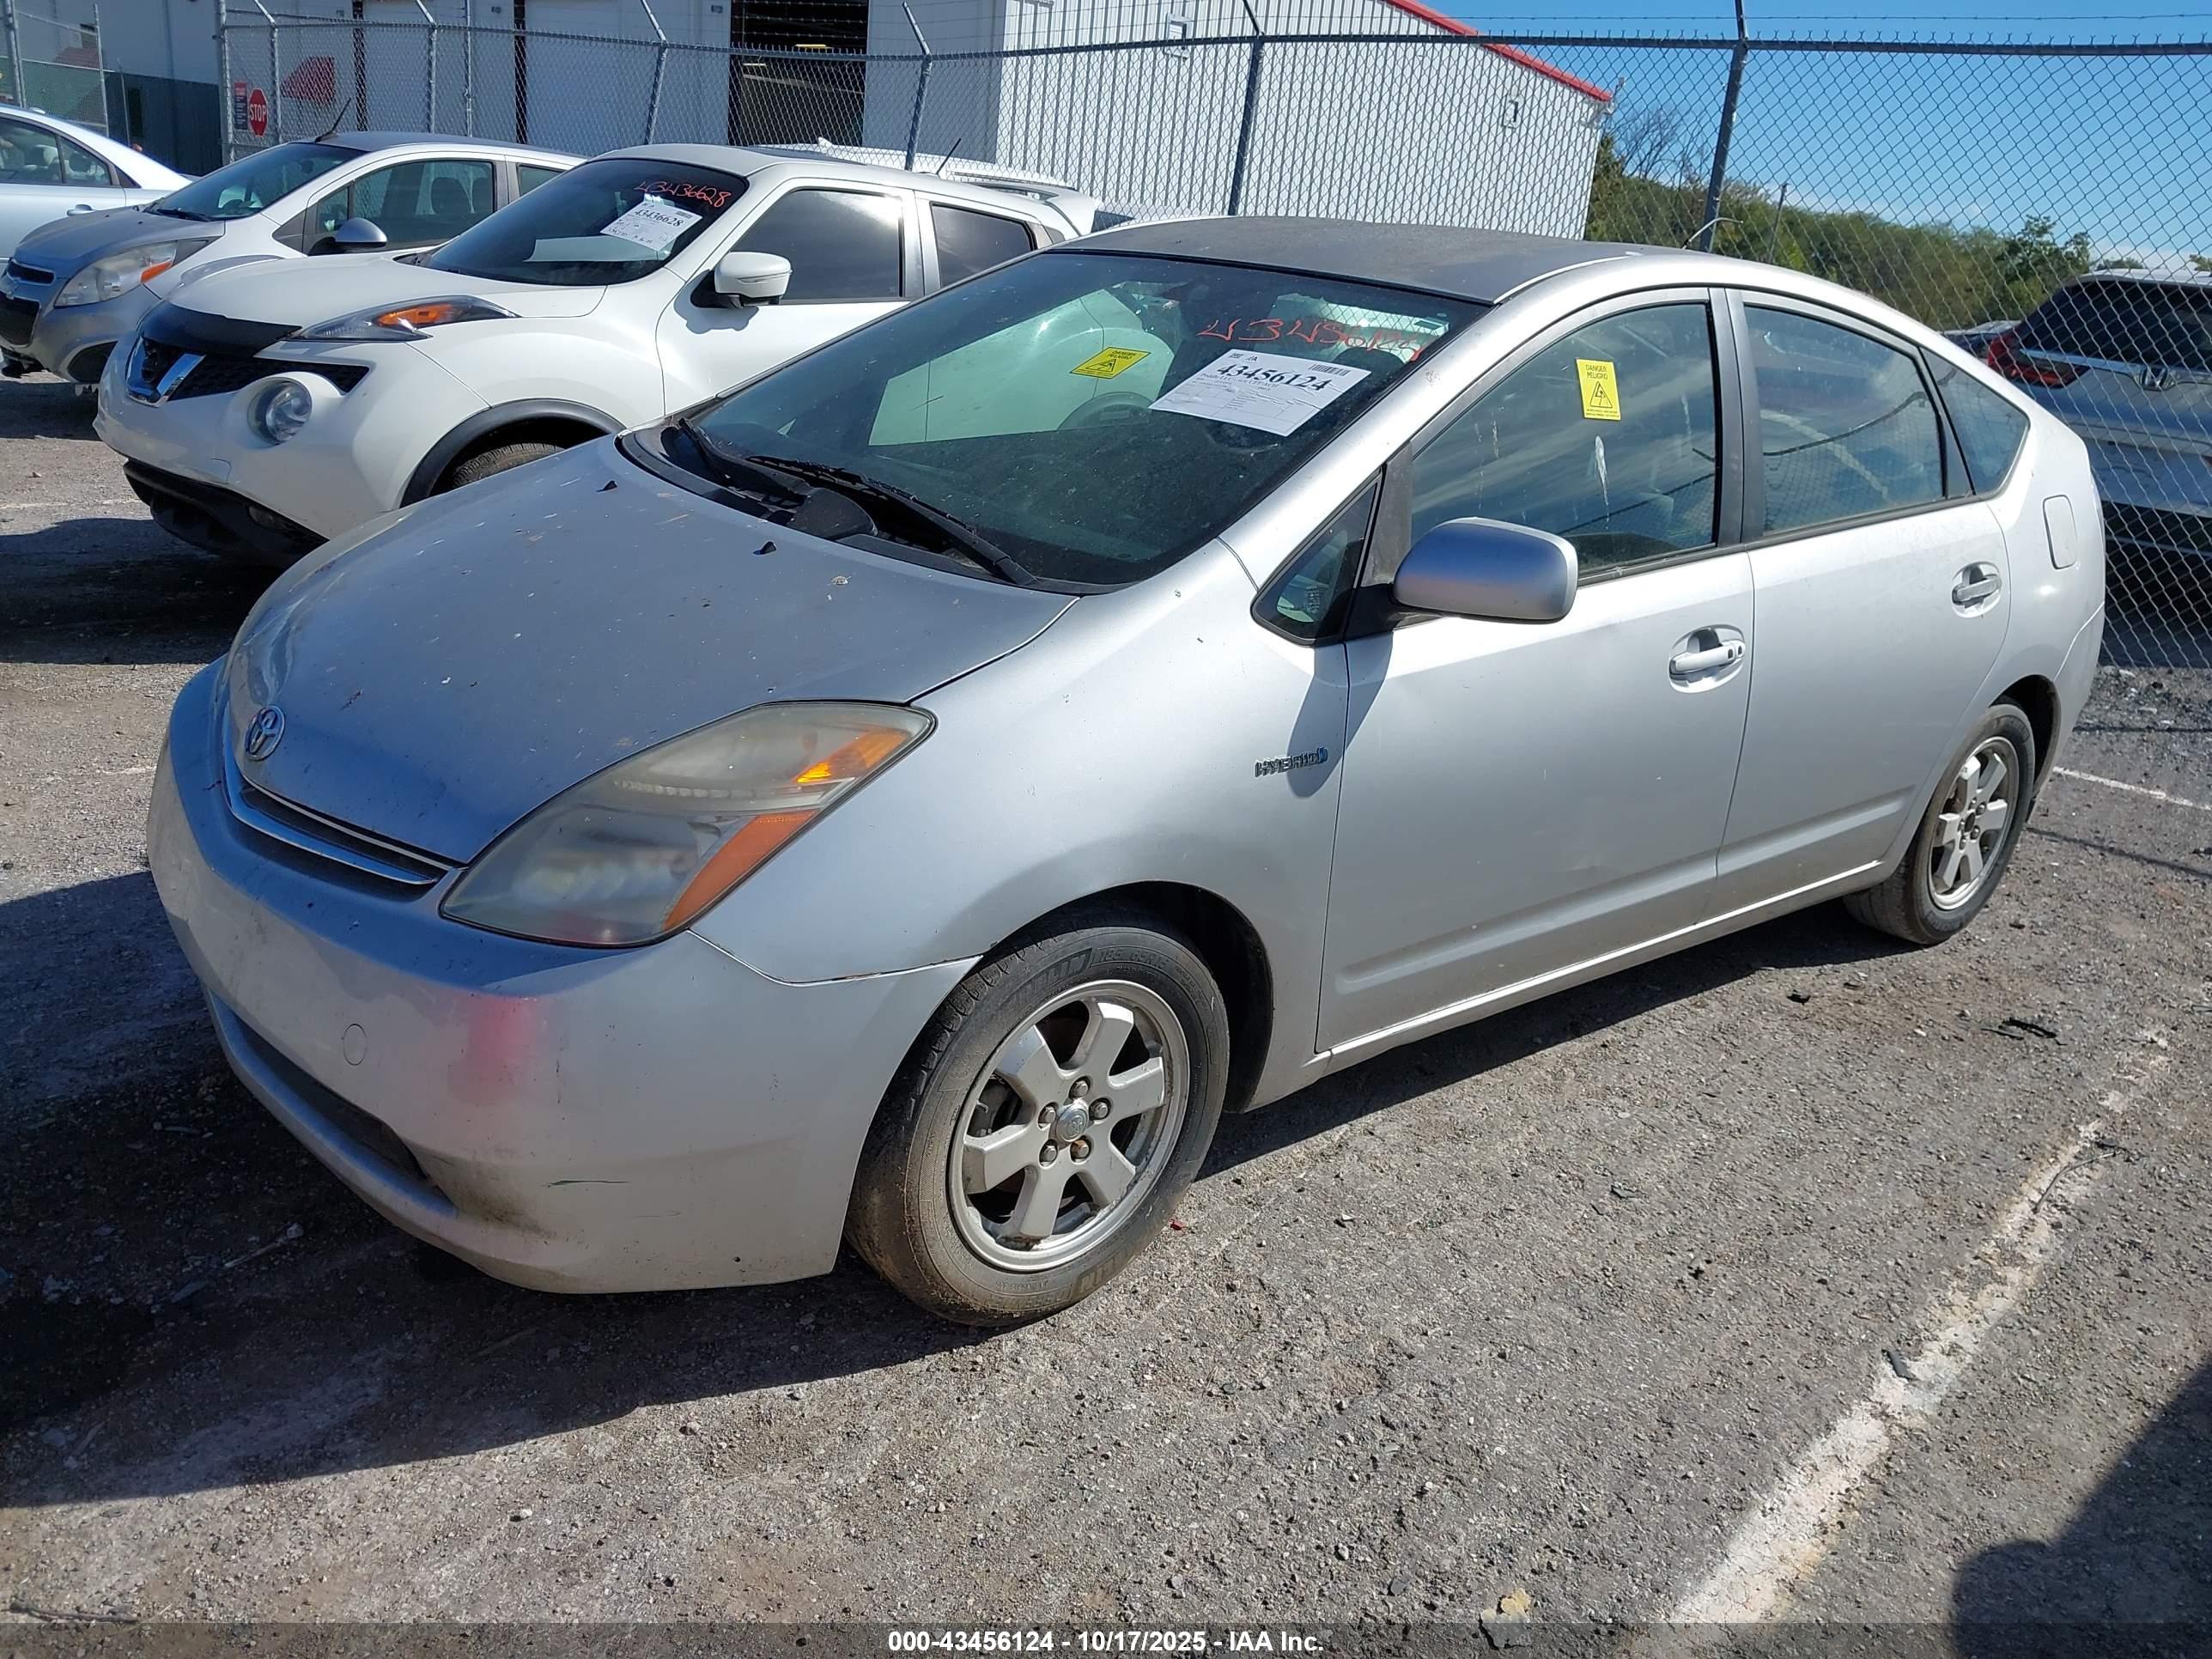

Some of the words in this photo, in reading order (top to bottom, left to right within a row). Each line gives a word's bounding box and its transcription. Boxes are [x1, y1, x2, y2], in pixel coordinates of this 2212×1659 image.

[250, 103, 266, 122] STOP
[634, 181, 732, 207] 43436628
[634, 209, 684, 228] 43436628
[1217, 363, 1332, 391] 43456124
[1586, 371, 1608, 380] PELIGRO
[1255, 746, 1328, 777] HYBRID
